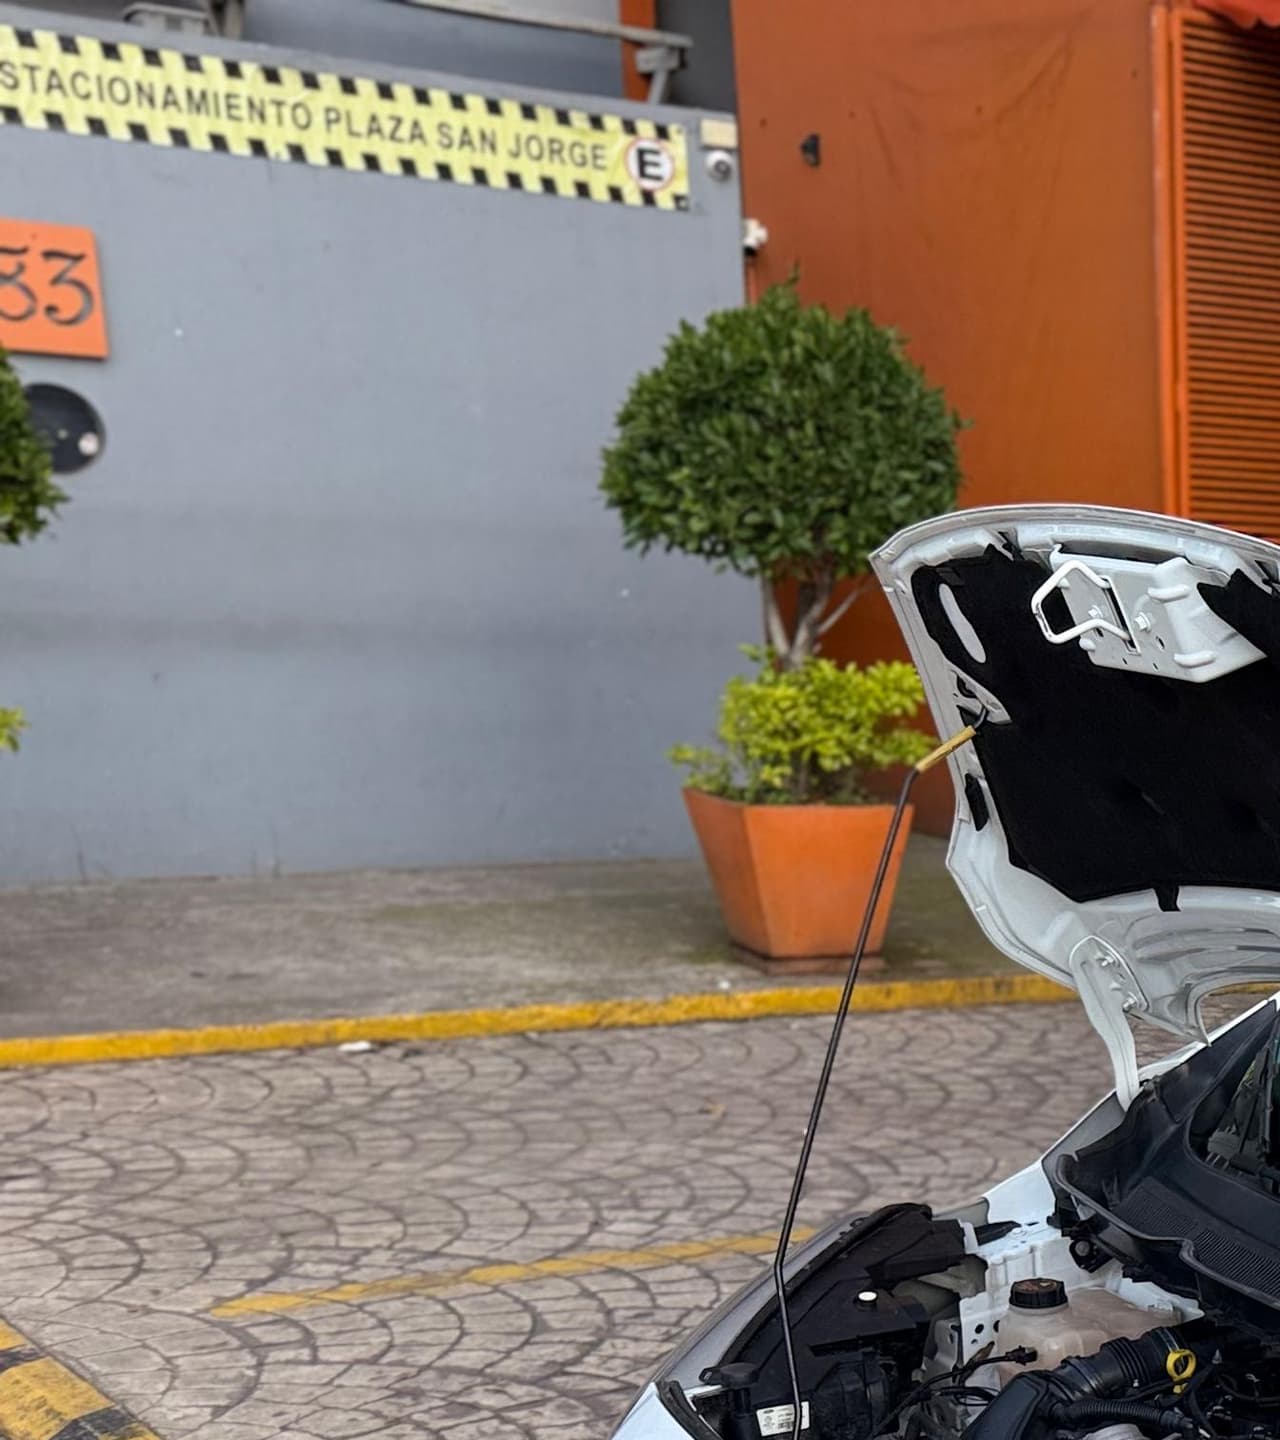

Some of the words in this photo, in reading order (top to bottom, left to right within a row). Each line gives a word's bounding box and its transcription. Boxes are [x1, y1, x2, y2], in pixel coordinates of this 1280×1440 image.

[0, 63, 312, 132] STACIONAMIENTO
[324, 111, 427, 147] PLAZA
[437, 122, 498, 156] SAN
[508, 132, 608, 171] JORGE
[637, 147, 663, 181] E
